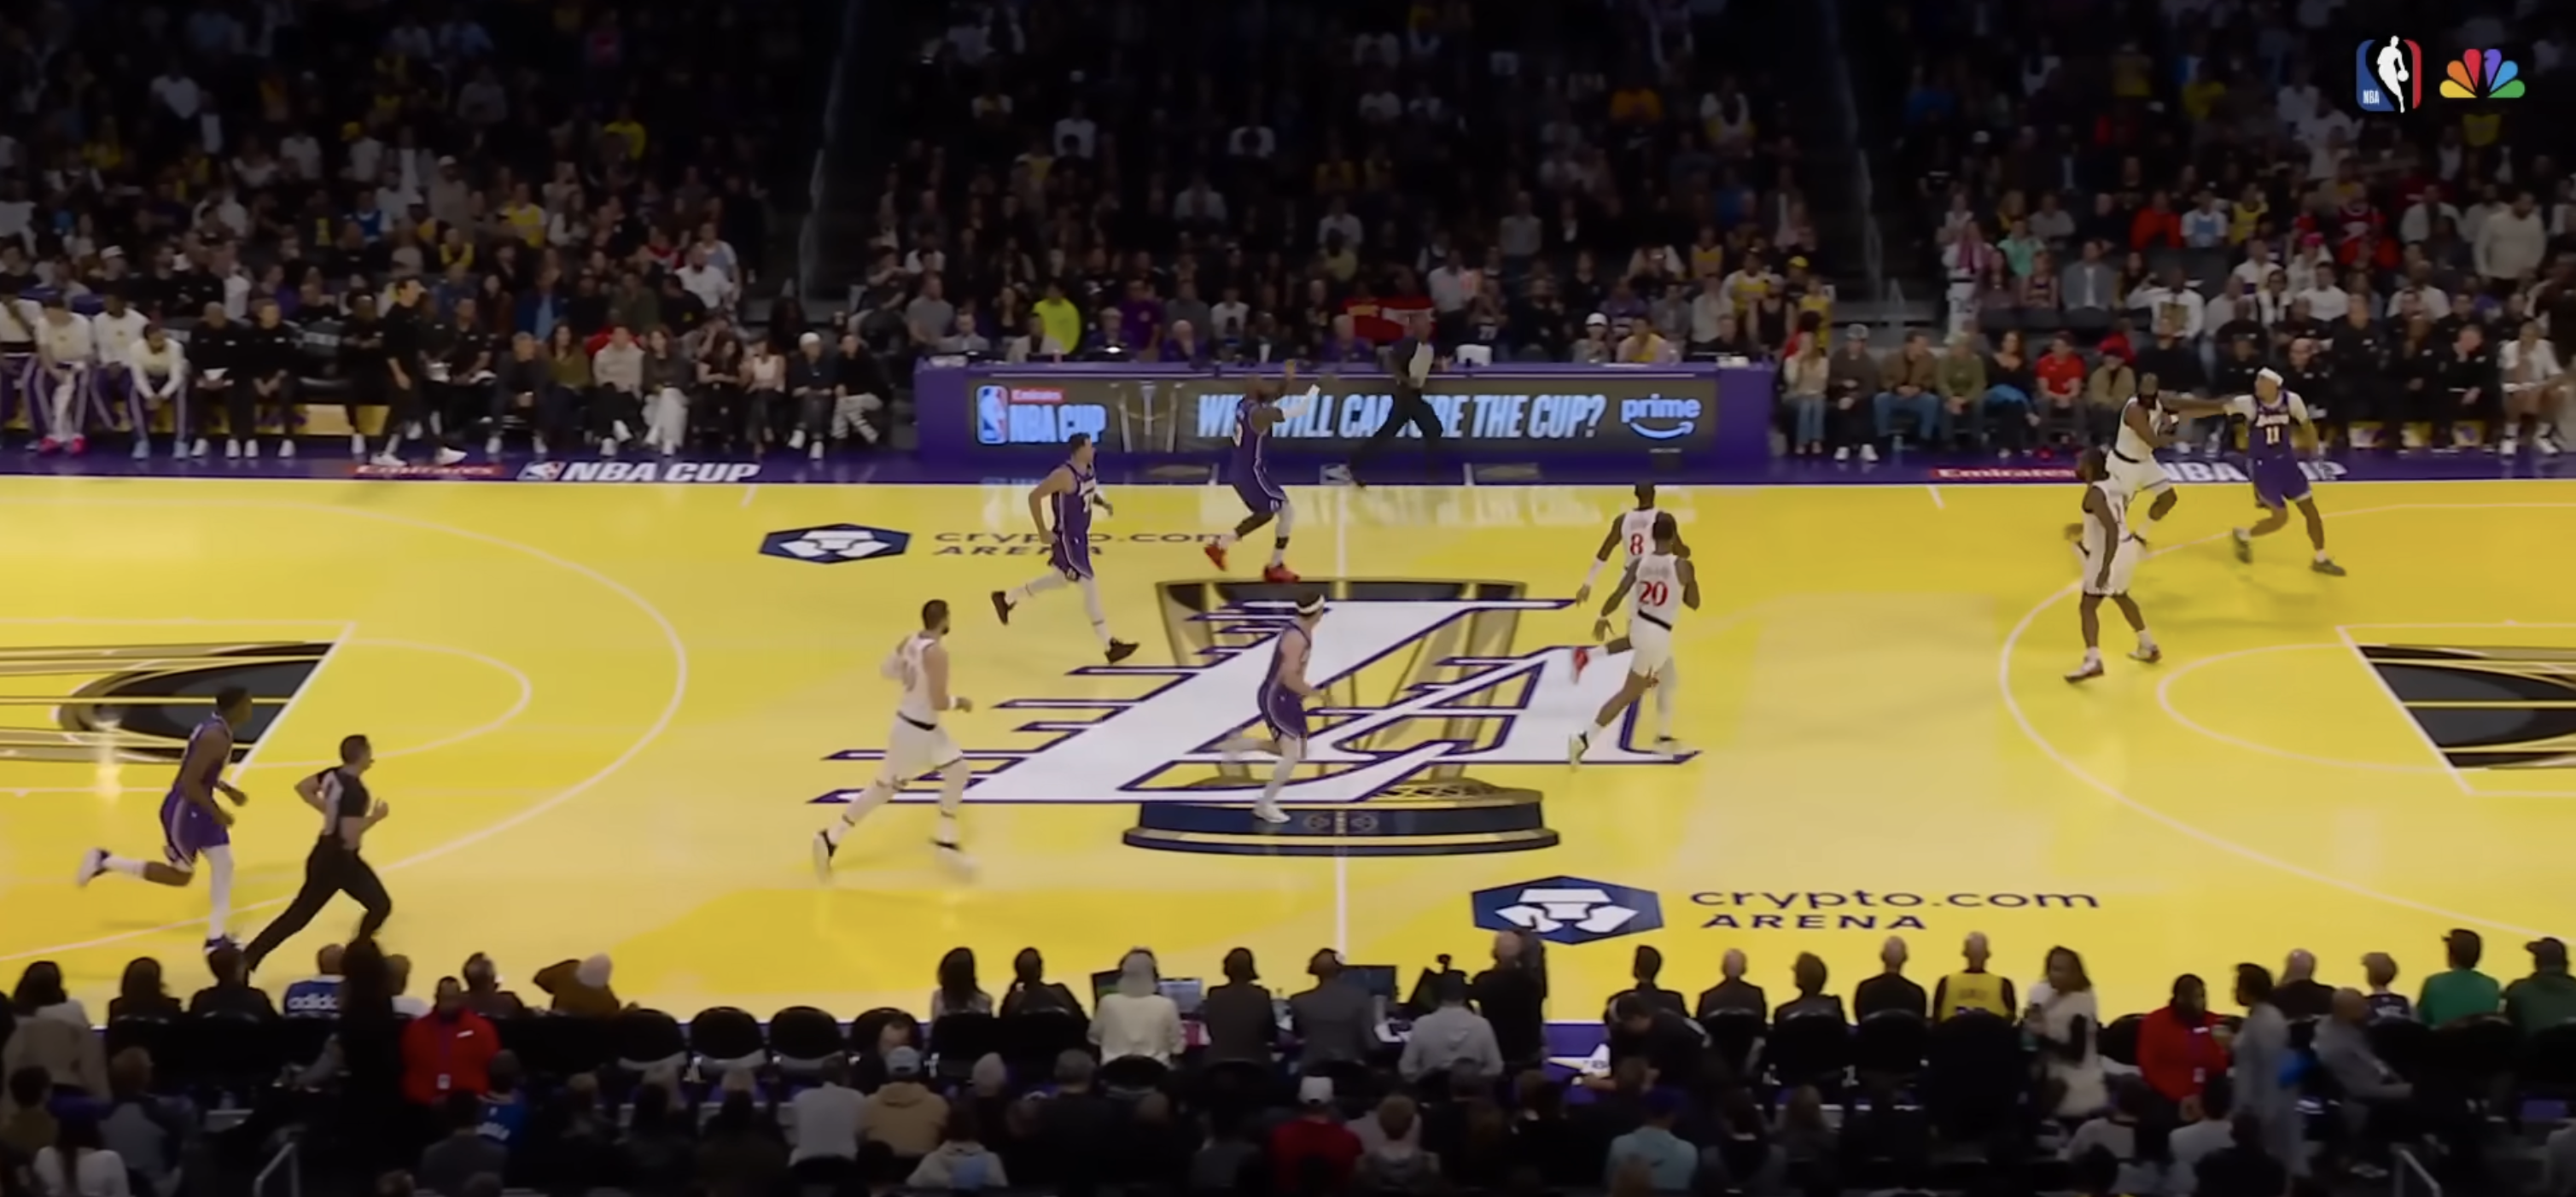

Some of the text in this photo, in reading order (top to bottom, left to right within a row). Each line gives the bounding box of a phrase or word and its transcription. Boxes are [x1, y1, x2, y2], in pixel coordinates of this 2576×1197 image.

[1471, 394, 1529, 438] THE
[1526, 394, 1606, 438] CUP?
[1621, 393, 1701, 423] prime
[2265, 426, 2280, 444] 11
[560, 462, 761, 482] NBA CUP
[1629, 533, 1644, 556] 8
[1638, 580, 1669, 607] 20
[1690, 890, 2100, 909] crypto.com
[1700, 914, 1926, 930] ARENA
